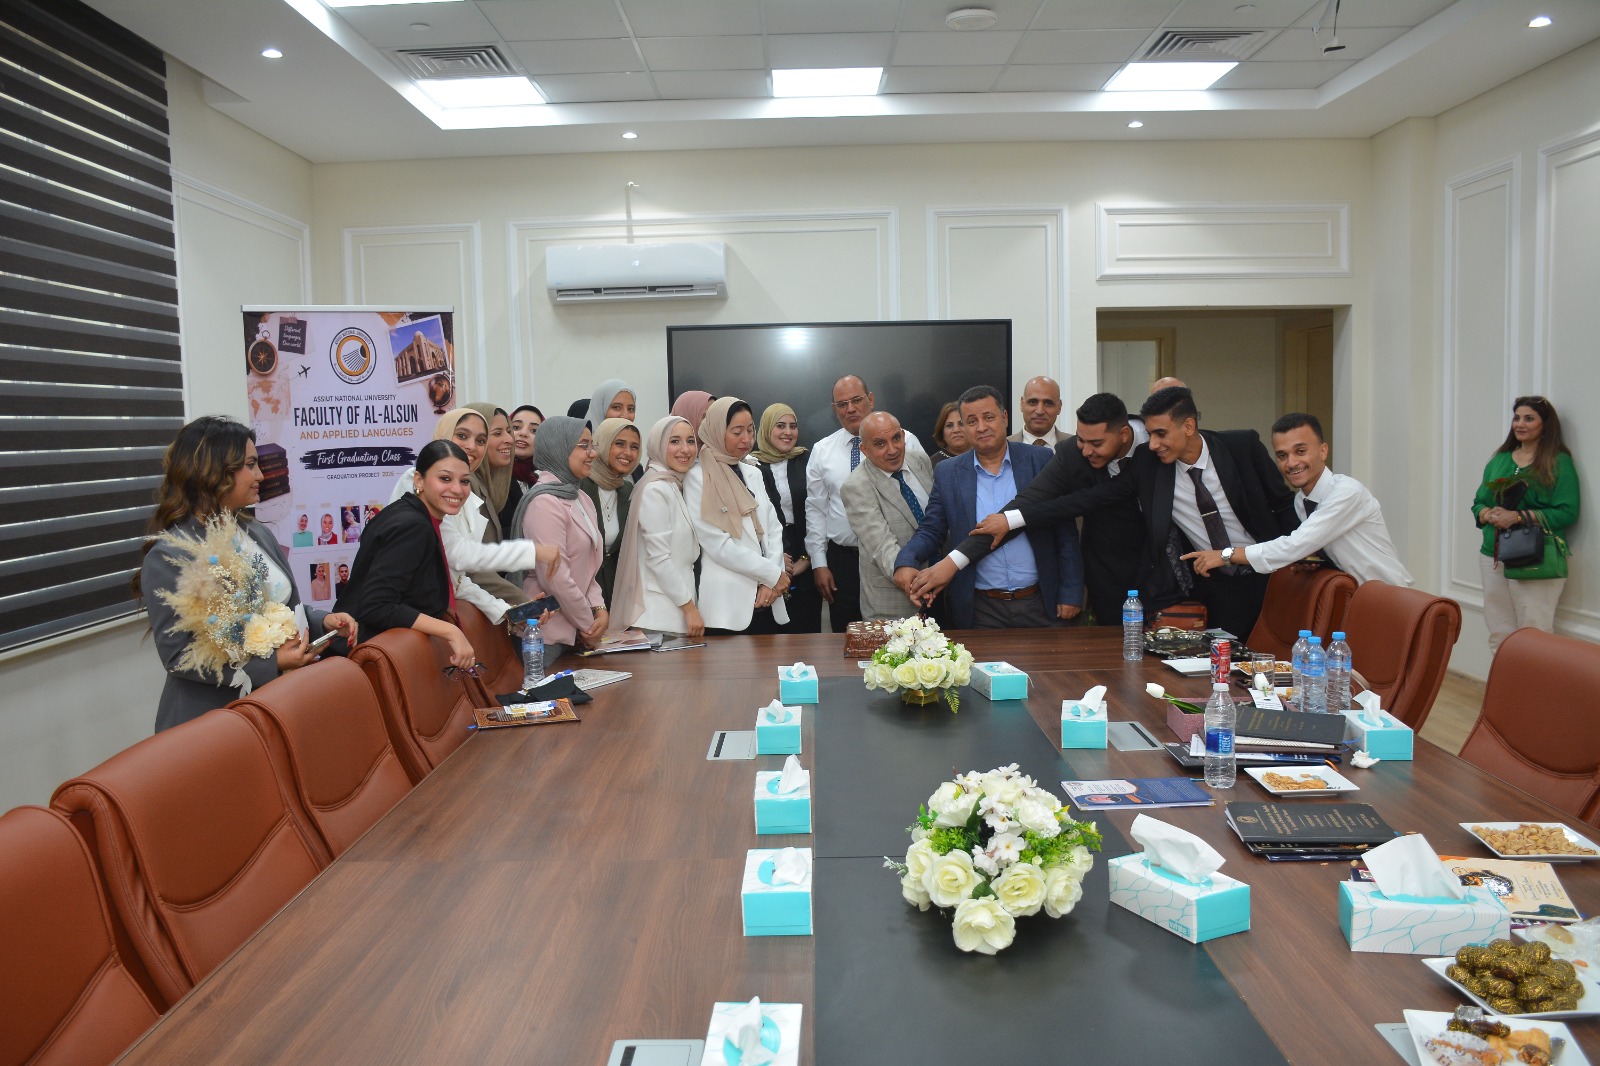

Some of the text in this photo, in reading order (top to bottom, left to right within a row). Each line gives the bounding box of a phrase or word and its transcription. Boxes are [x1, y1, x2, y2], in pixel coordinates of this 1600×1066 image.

[293, 404, 418, 427] FACULTY OF AL-ALSUN
[300, 427, 414, 440] AND APPLIED LANGUAGES
[317, 449, 402, 466] First Graduating Class
